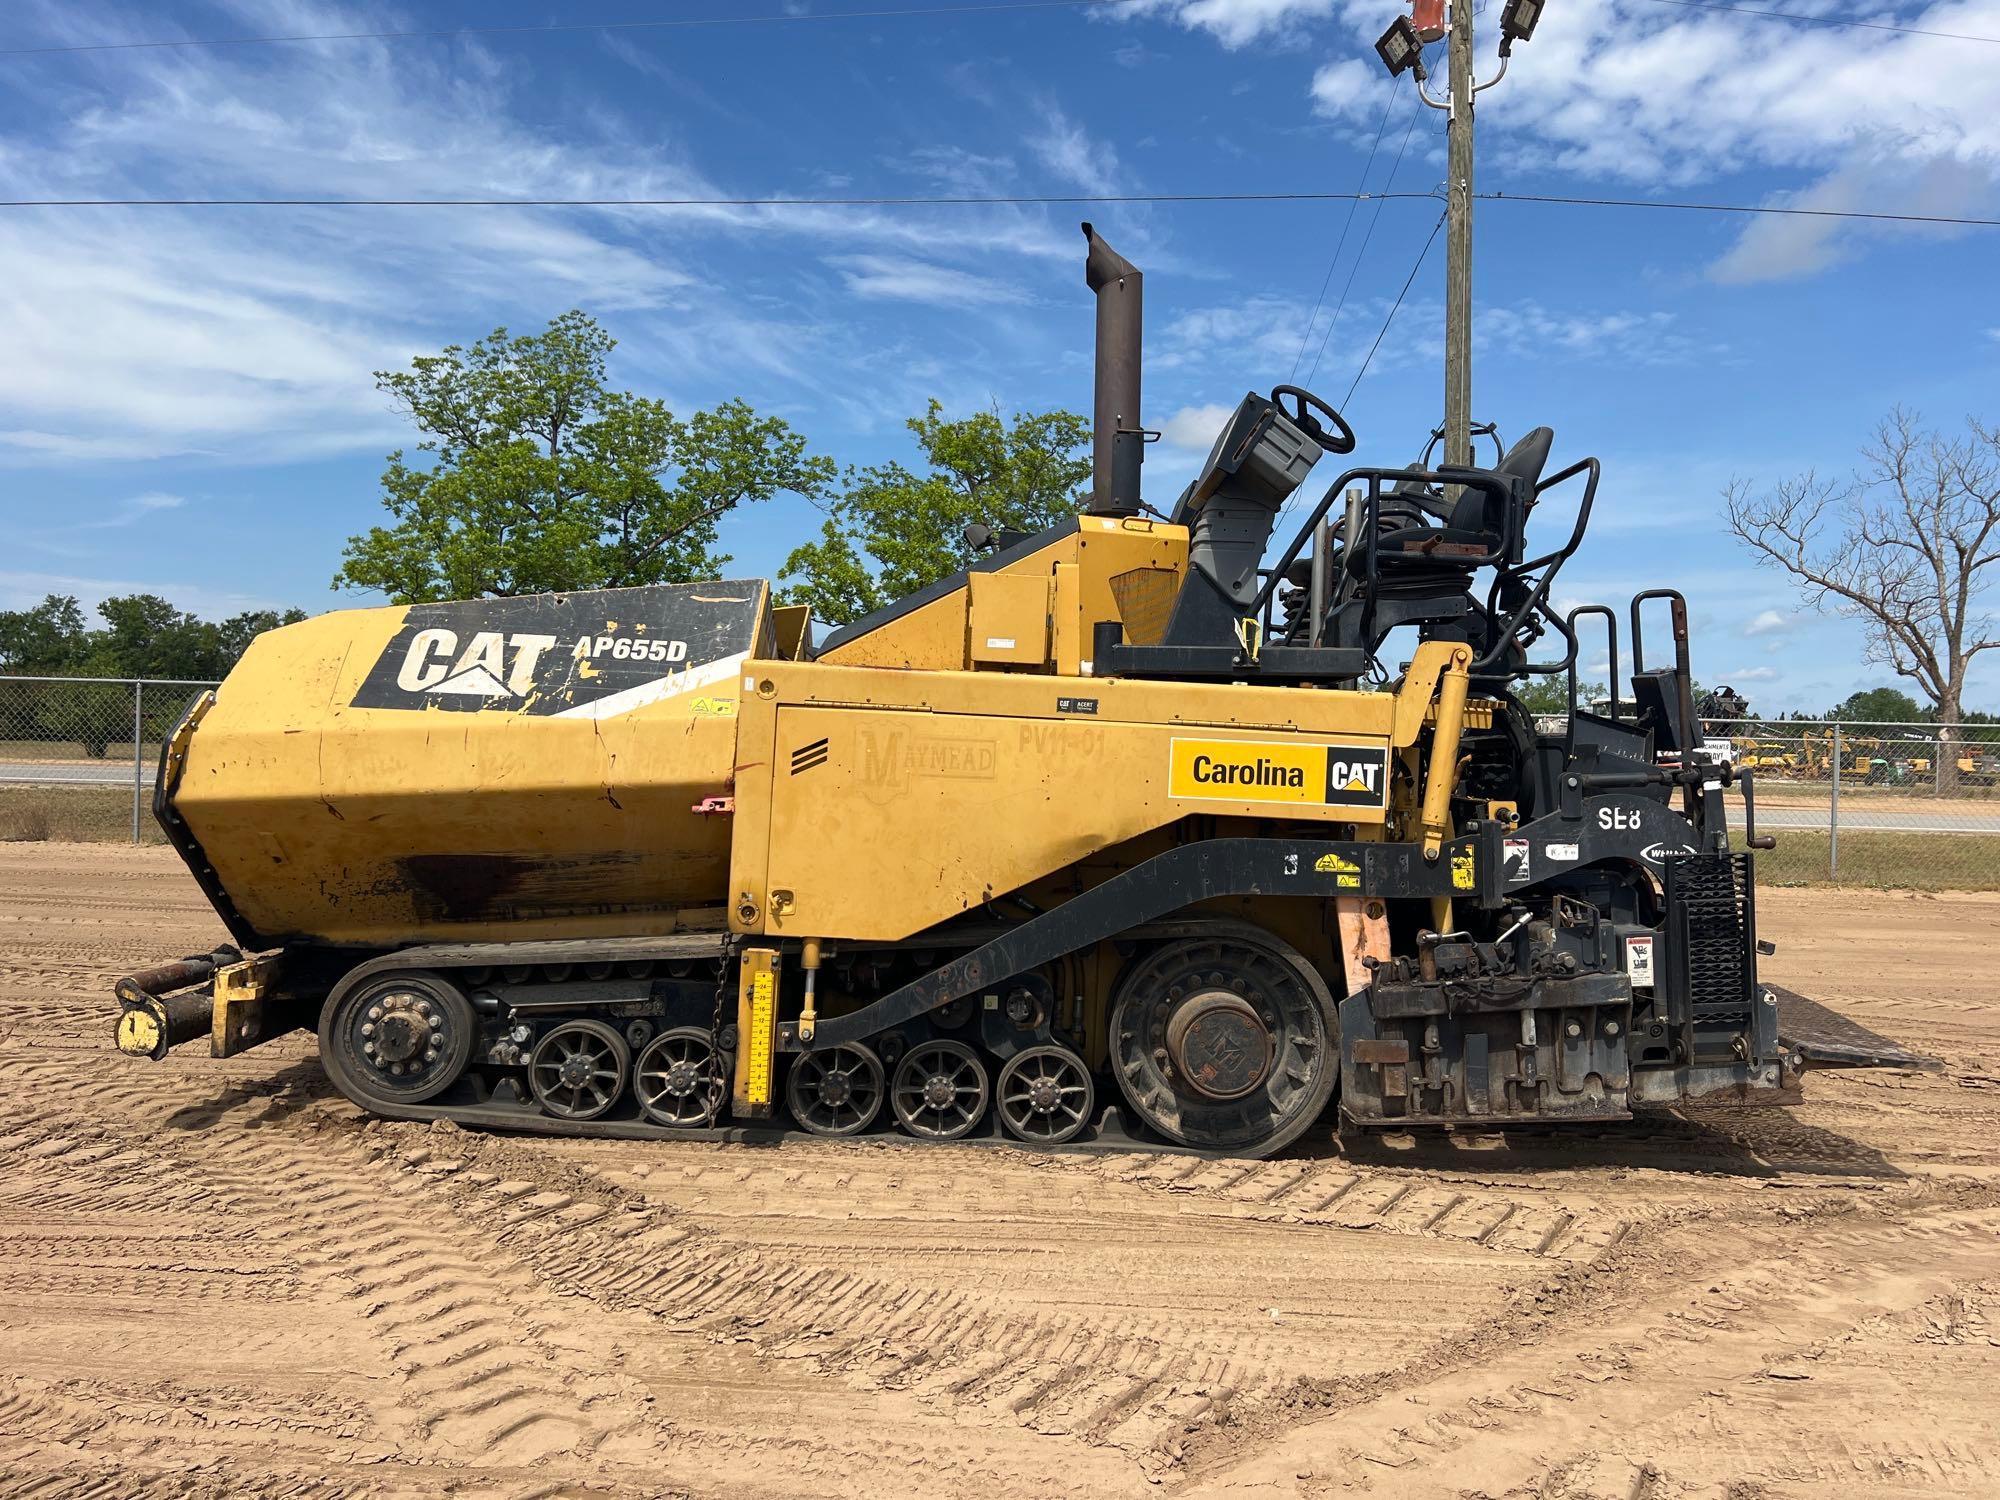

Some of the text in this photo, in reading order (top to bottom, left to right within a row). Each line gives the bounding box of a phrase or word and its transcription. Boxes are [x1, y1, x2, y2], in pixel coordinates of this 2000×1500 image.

[397, 628, 688, 698] CAT AP655D
[1193, 755, 1304, 787] Carolina
[1331, 761, 1379, 792] CAT
[1598, 807, 1641, 830] SE8
